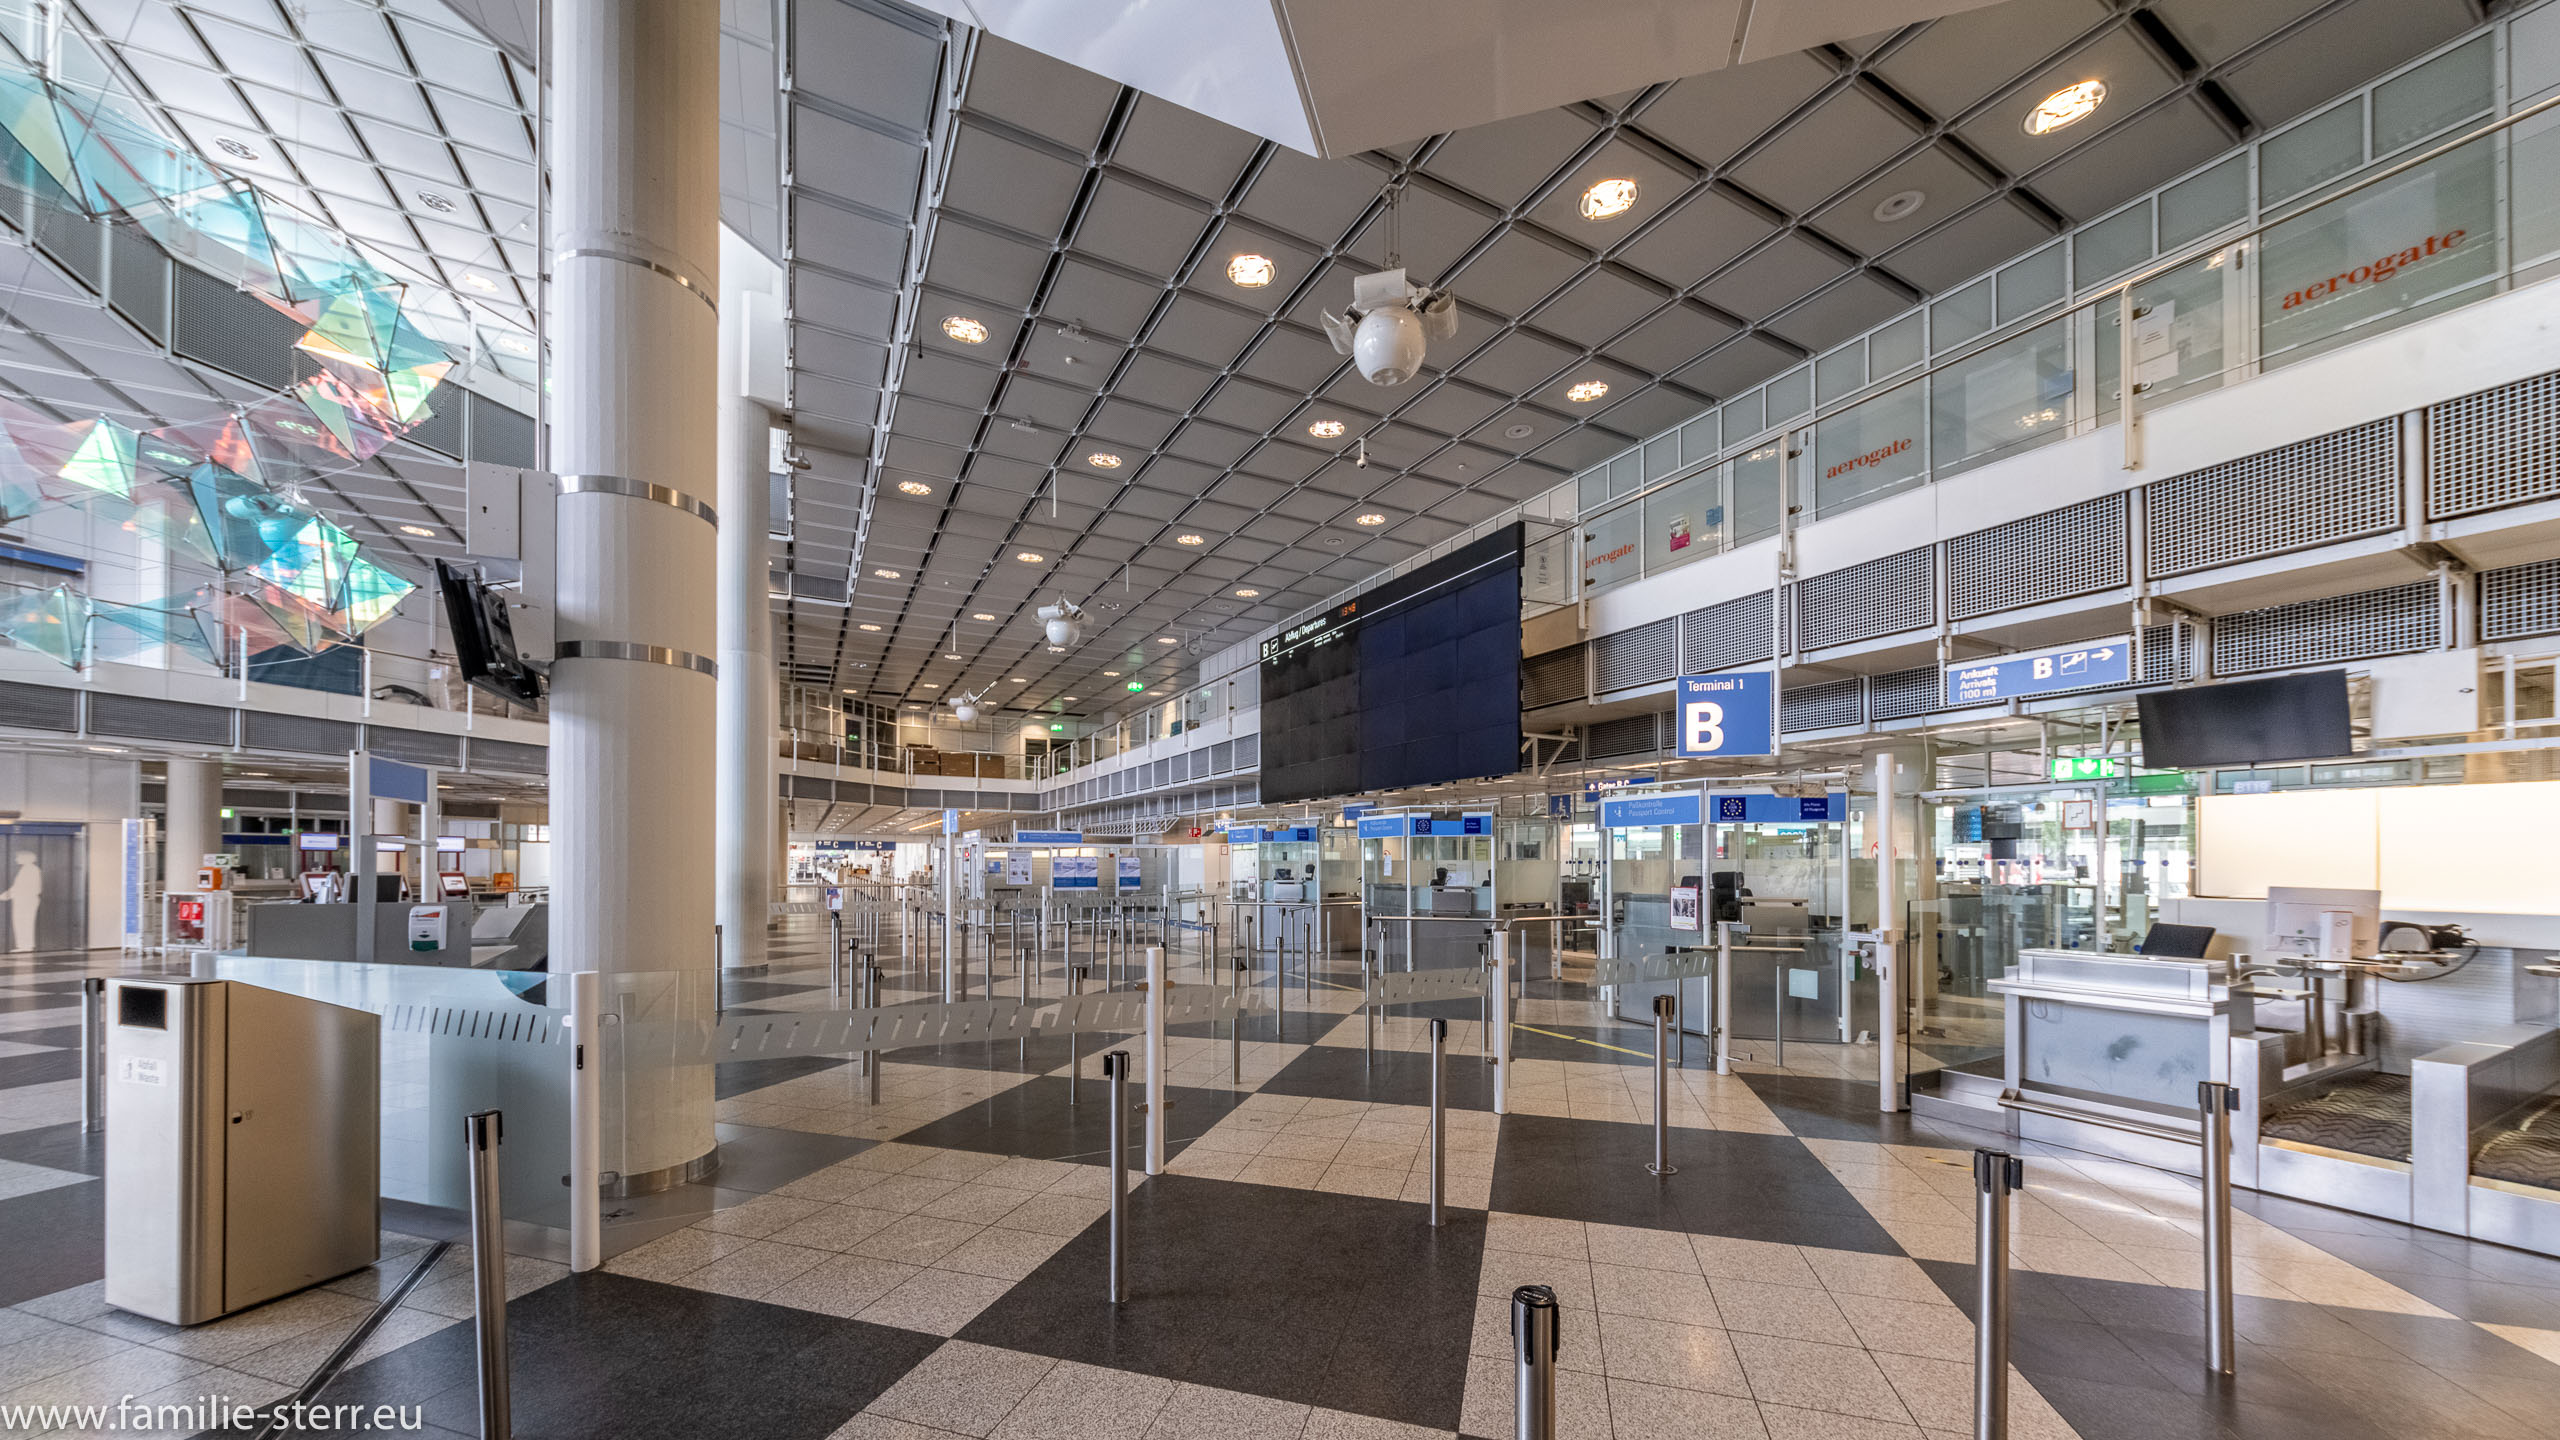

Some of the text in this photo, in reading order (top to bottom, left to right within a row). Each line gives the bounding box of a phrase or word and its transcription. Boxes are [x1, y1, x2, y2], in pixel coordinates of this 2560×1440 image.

[2282, 229, 2466, 310] aerogate
[1827, 438, 1912, 479] aerogate
[1263, 643, 1269, 658] B
[1301, 618, 1326, 635] Departures
[1960, 666, 1999, 680] Ankunft
[2033, 657, 2053, 680] B
[1686, 678, 1744, 692] Terminal 1
[1960, 677, 1997, 690] Arrivals
[1960, 686, 1997, 700] (100 m)
[1685, 701, 1725, 752] B
[1628, 807, 1675, 817] Passport Control
